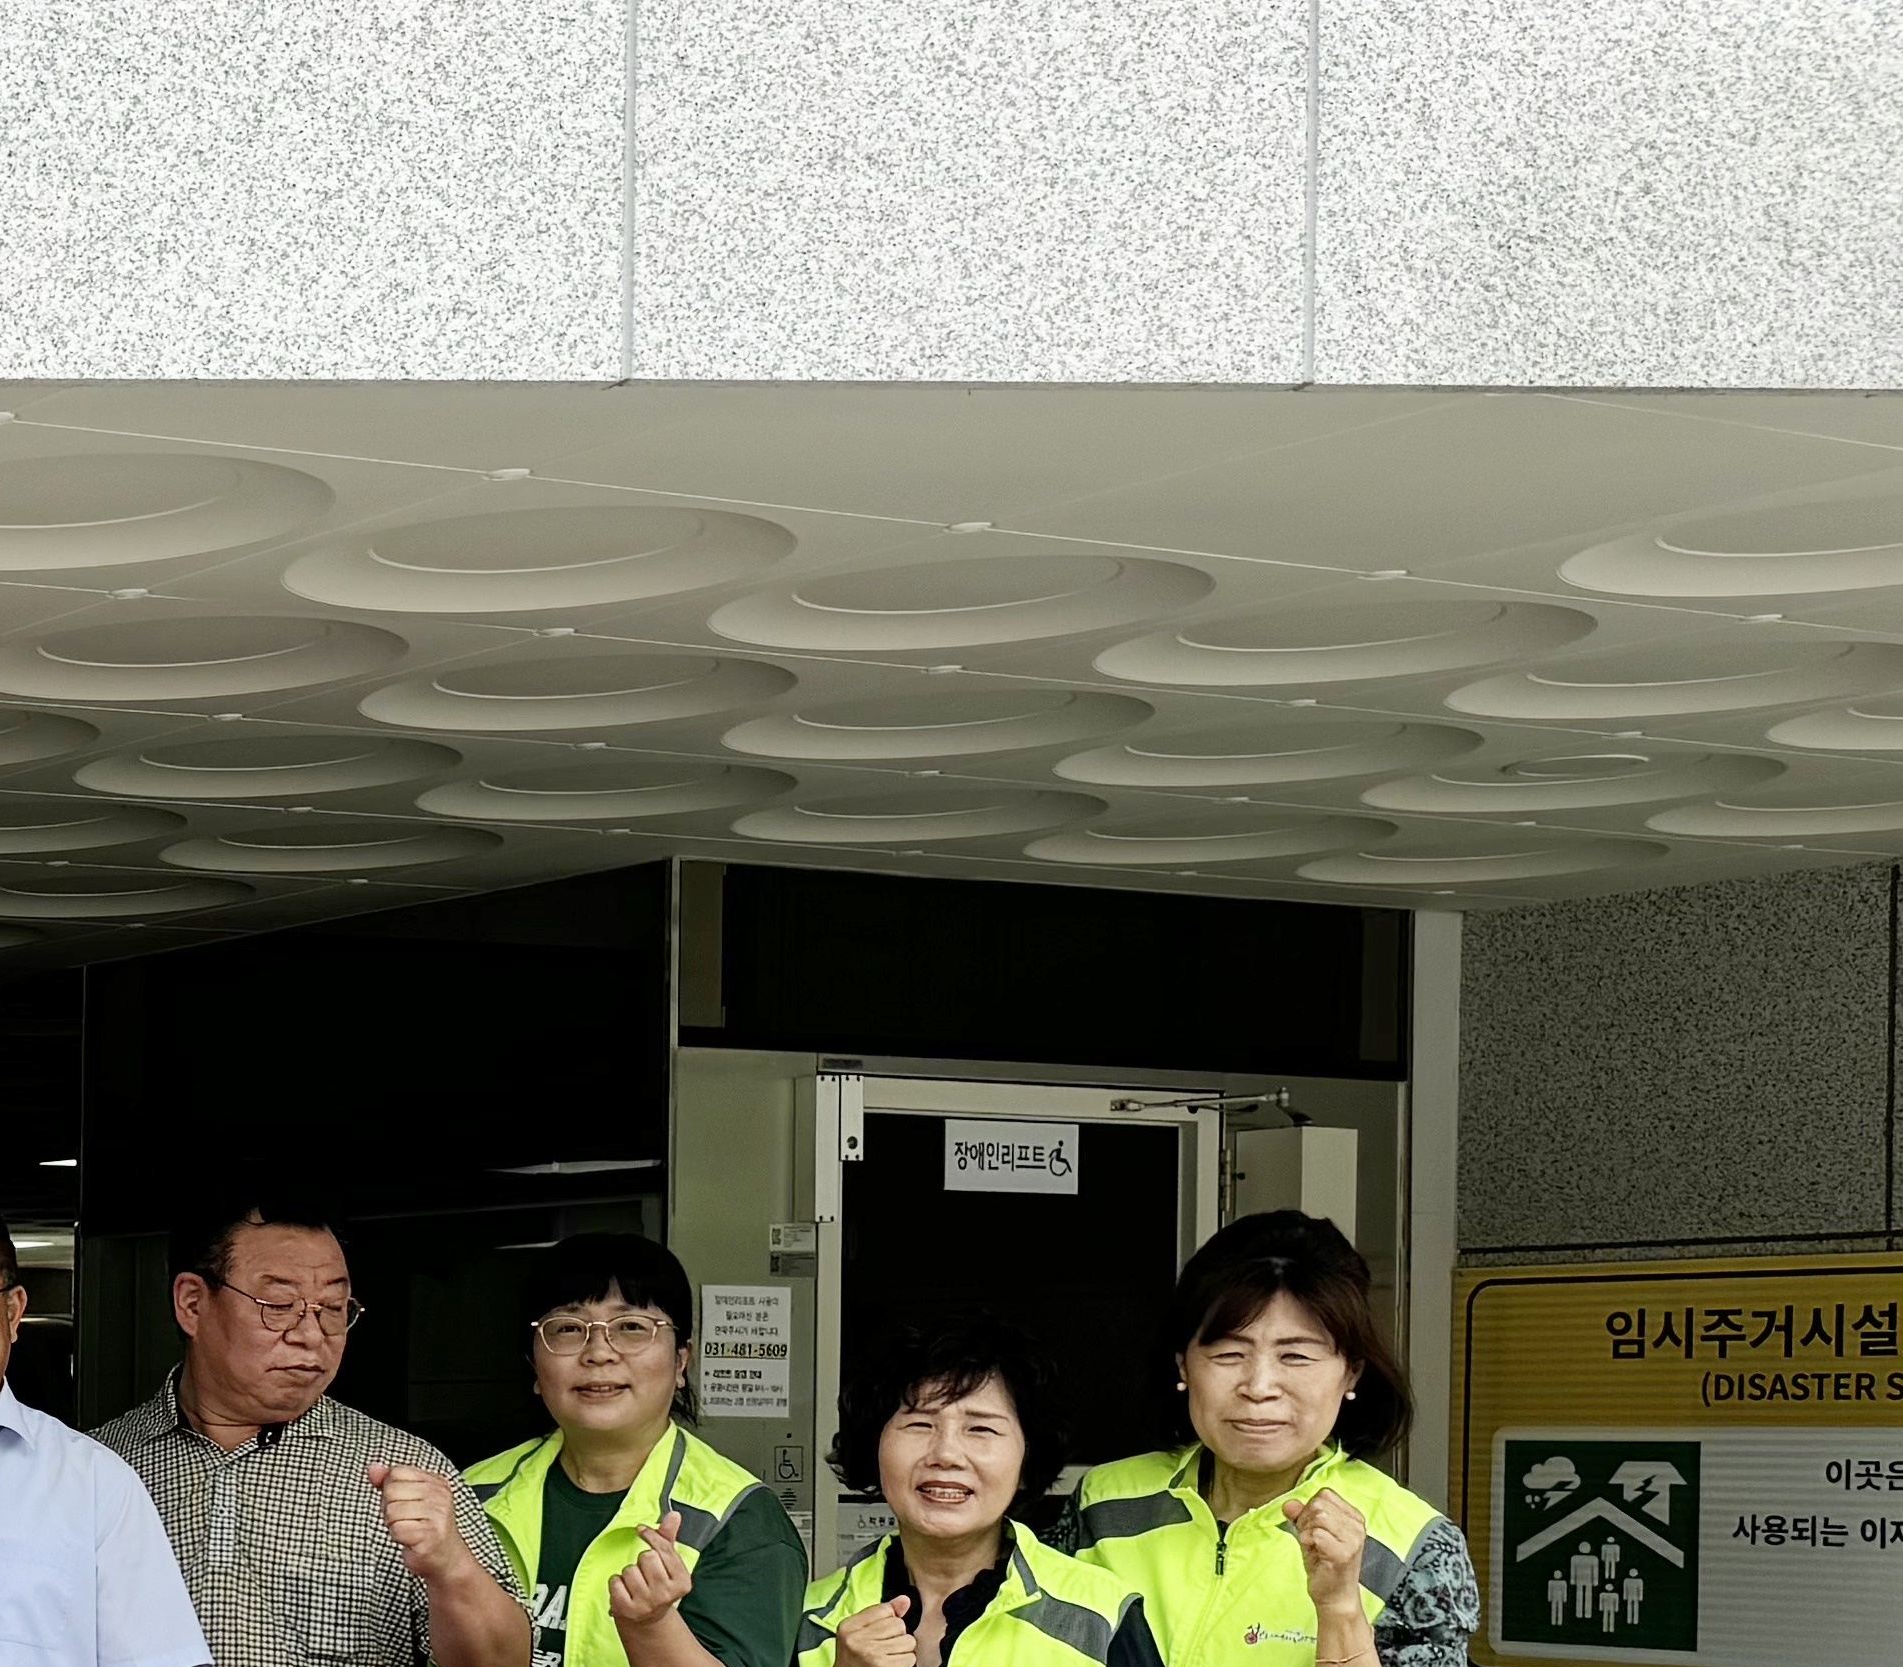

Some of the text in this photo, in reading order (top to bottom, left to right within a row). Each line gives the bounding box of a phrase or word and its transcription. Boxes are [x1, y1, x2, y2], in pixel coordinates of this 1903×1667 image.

[954, 1141, 1046, 1171] 장애인리프트
[1605, 1302, 1898, 1359] 임시주거시설
[1702, 1372, 1875, 1407] (DISASTER
[1733, 1514, 1848, 1547] 사용되는
